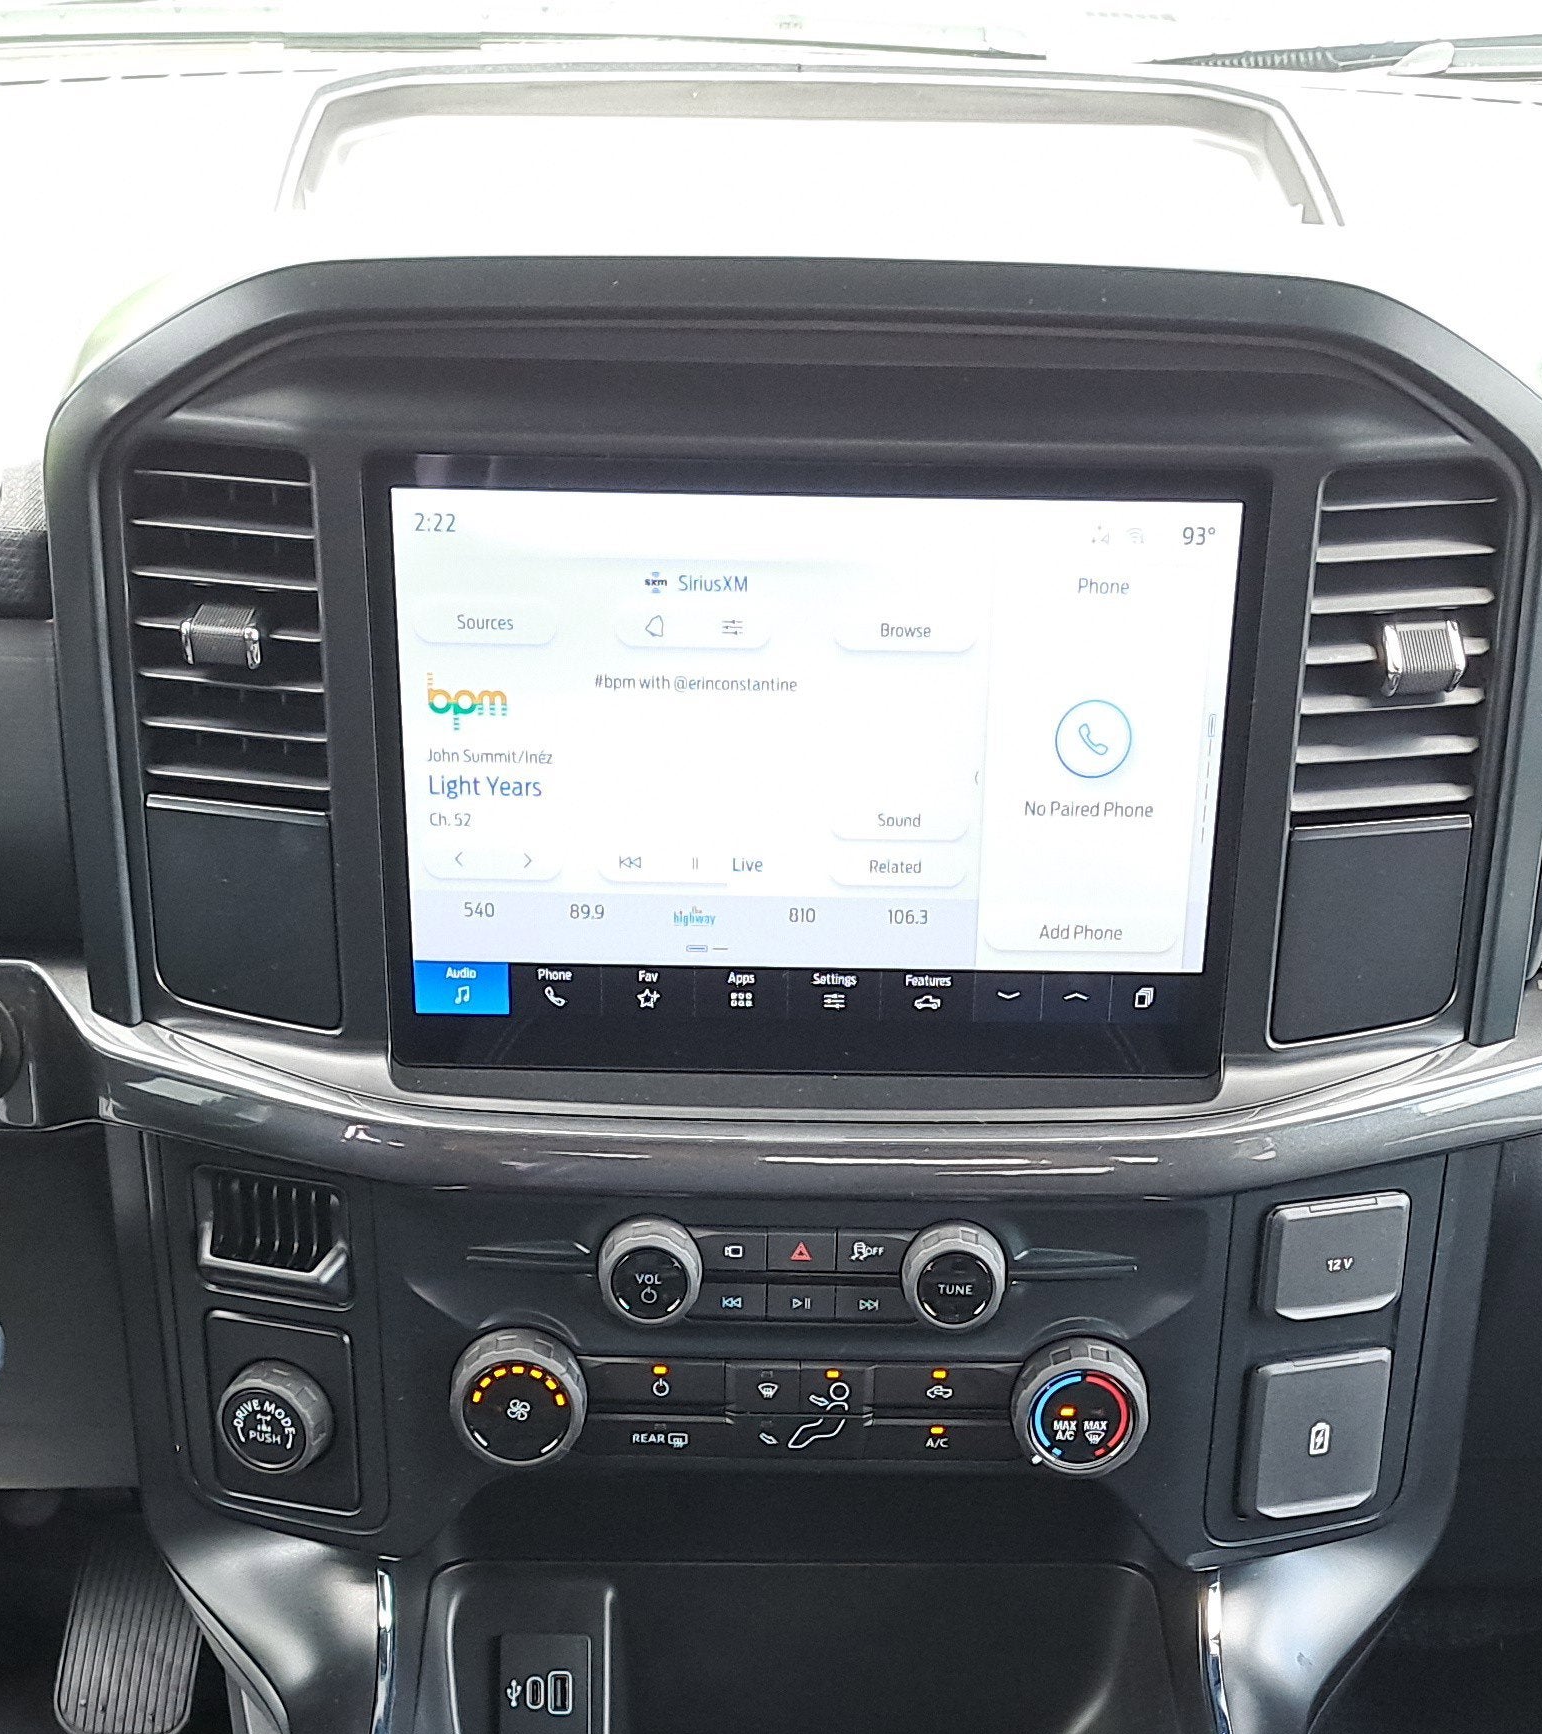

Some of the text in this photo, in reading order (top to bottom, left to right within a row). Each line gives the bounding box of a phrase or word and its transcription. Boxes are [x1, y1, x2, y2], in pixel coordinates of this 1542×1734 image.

[414, 512, 457, 533] 2:22
[1182, 525, 1217, 547] 93°
[677, 574, 749, 593] SiriusXM
[1077, 577, 1130, 595] Phone
[457, 613, 514, 631] Sources
[880, 622, 932, 639] Browse
[595, 674, 798, 693] #bpm with @erinconstantine
[427, 672, 508, 730] bpm
[427, 748, 460, 763] John
[428, 774, 542, 800] Light Years
[1024, 800, 1154, 819] No Paired Phone
[430, 812, 471, 827] Ch. 52
[877, 812, 921, 828] Sound
[732, 856, 763, 873] Live
[869, 859, 922, 875] Related
[463, 901, 495, 918] 540
[569, 903, 605, 920] 89.9
[788, 906, 816, 924] 810
[887, 908, 928, 925] 106.3
[673, 910, 716, 926] highway
[1039, 924, 1123, 941] Add Phone
[445, 966, 477, 980] Audio
[537, 967, 573, 982] Phone
[638, 969, 659, 983] Fav
[727, 972, 756, 986] Apps
[812, 972, 858, 988] Settings
[905, 973, 952, 987] Features
[865, 1246, 885, 1256] OFF
[1326, 1256, 1354, 1272] 12 V
[634, 1273, 662, 1285] VOL
[937, 1283, 974, 1296] TUNE
[233, 1398, 296, 1436] DRIVE MODE
[1053, 1420, 1077, 1432] MAX
[1083, 1420, 1108, 1432] MAX
[248, 1429, 282, 1445] PUSH
[632, 1432, 665, 1444] REAR
[925, 1437, 949, 1449] A/C
[1054, 1430, 1075, 1442] A/C
